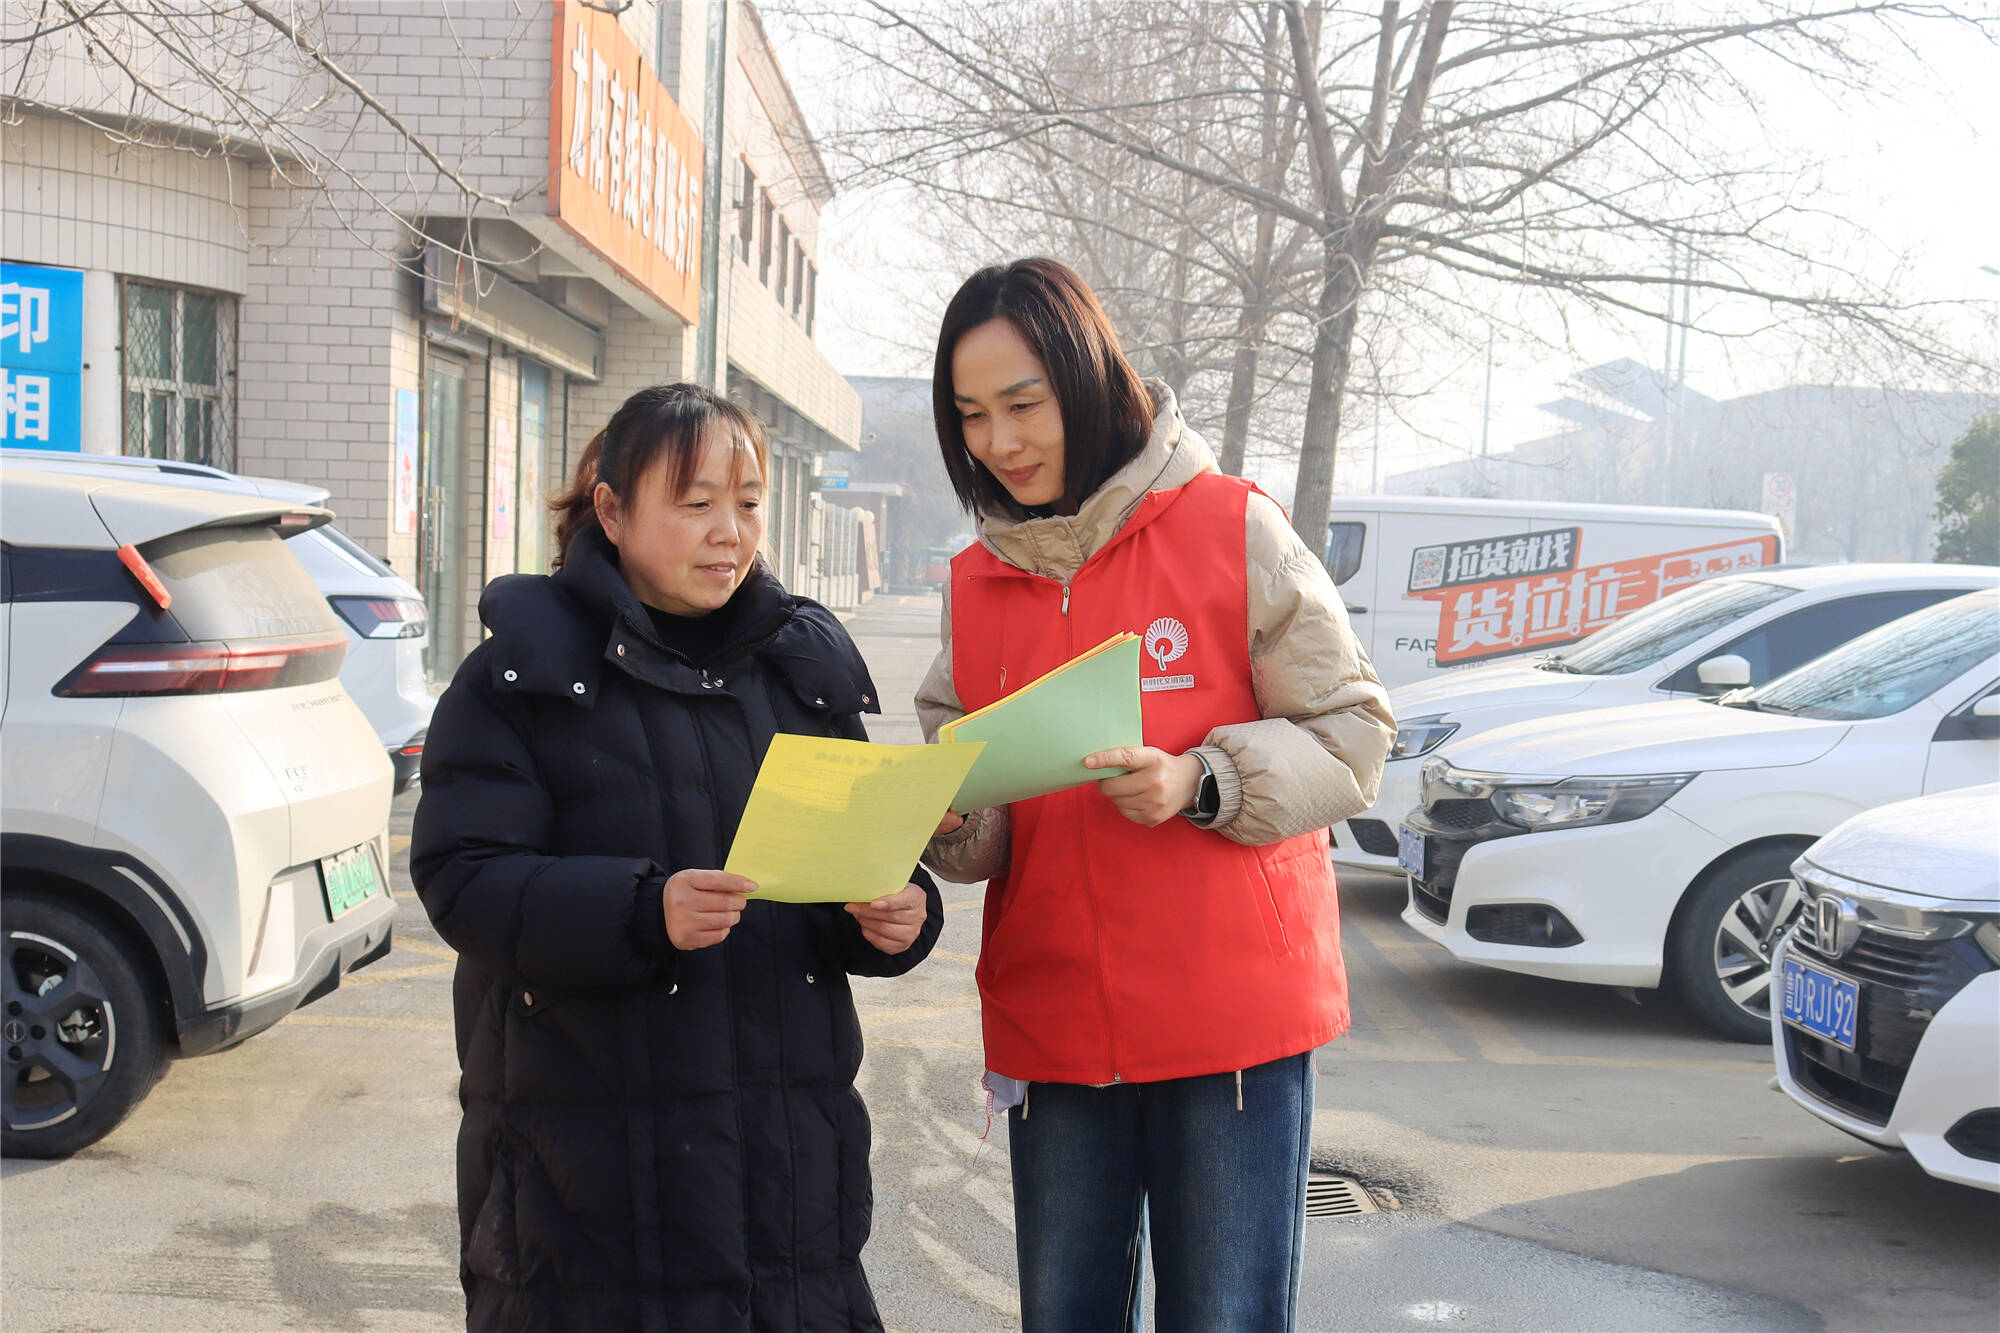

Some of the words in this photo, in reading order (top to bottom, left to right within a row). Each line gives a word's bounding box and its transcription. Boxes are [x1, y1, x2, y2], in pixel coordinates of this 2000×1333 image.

[0, 281, 50, 354] 印
[0, 368, 50, 441] 相
[1446, 531, 1572, 583] 拉货就找
[1447, 567, 1633, 655] 货拉拉
